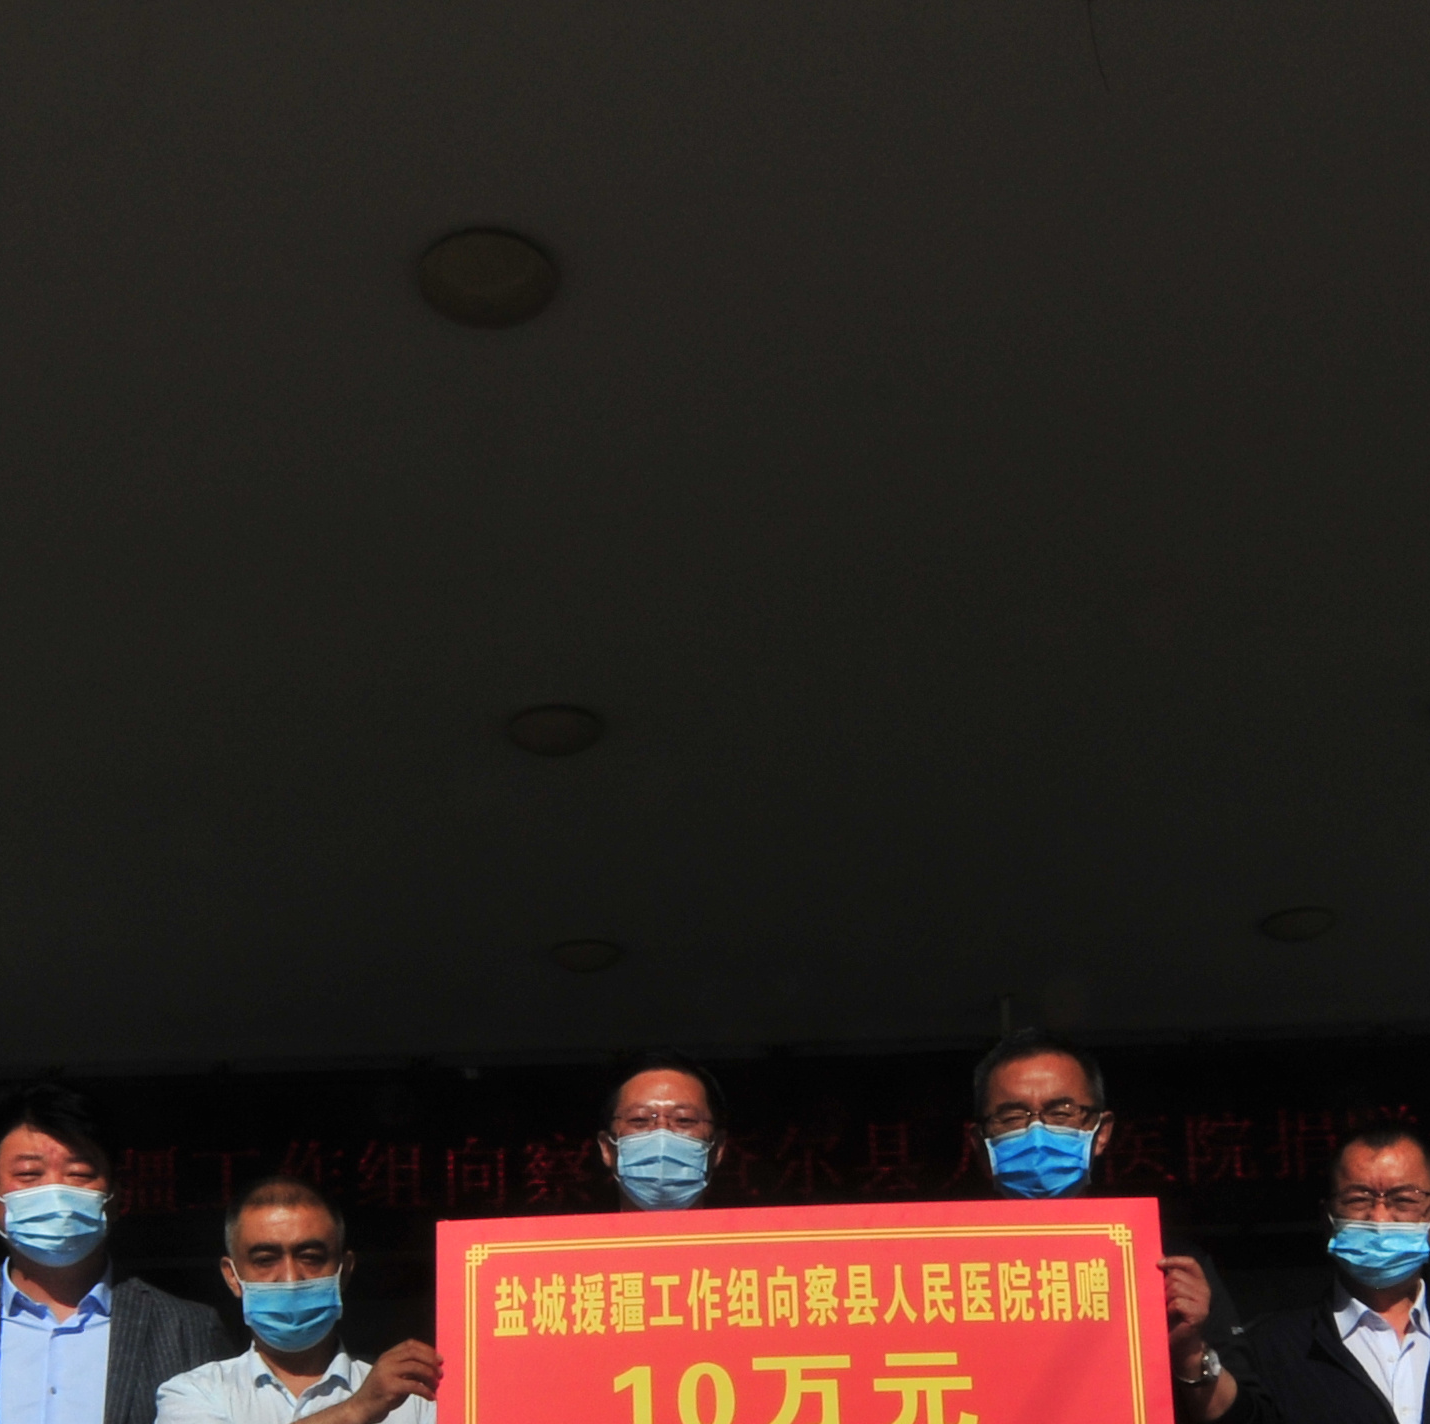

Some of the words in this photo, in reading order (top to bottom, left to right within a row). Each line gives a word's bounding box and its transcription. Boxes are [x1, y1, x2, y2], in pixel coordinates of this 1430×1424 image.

[493, 1258, 1111, 1337] 盐城援疆工作组向察县人民医院捐赠
